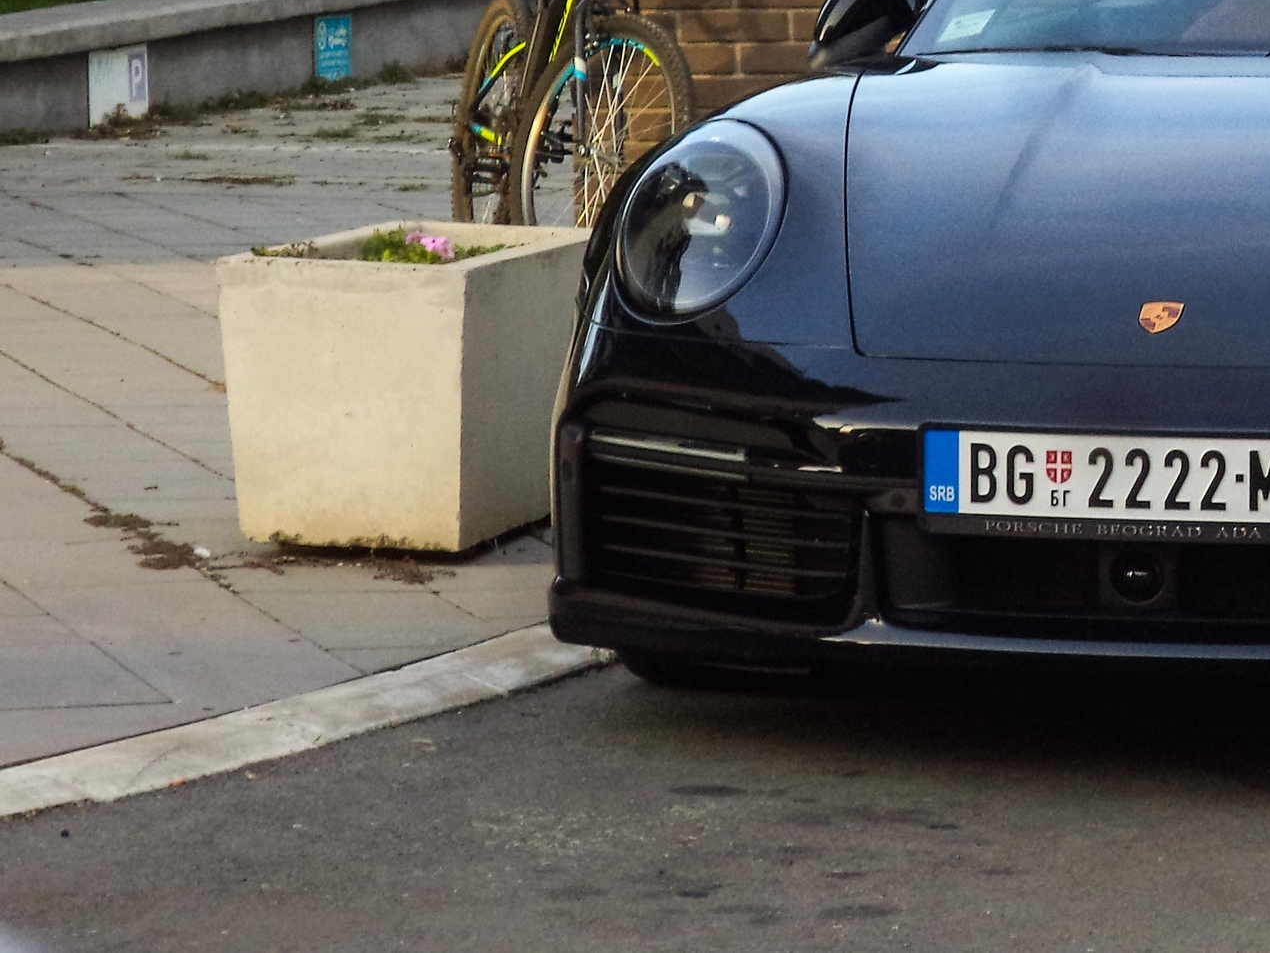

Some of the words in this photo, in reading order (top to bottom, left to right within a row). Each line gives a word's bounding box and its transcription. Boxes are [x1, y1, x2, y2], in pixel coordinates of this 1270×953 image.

[970, 442, 1035, 505] BG
[929, 485, 955, 502] SRB
[984, 519, 1083, 535] PORSCHE
[1097, 523, 1202, 537] BEOGRAD
